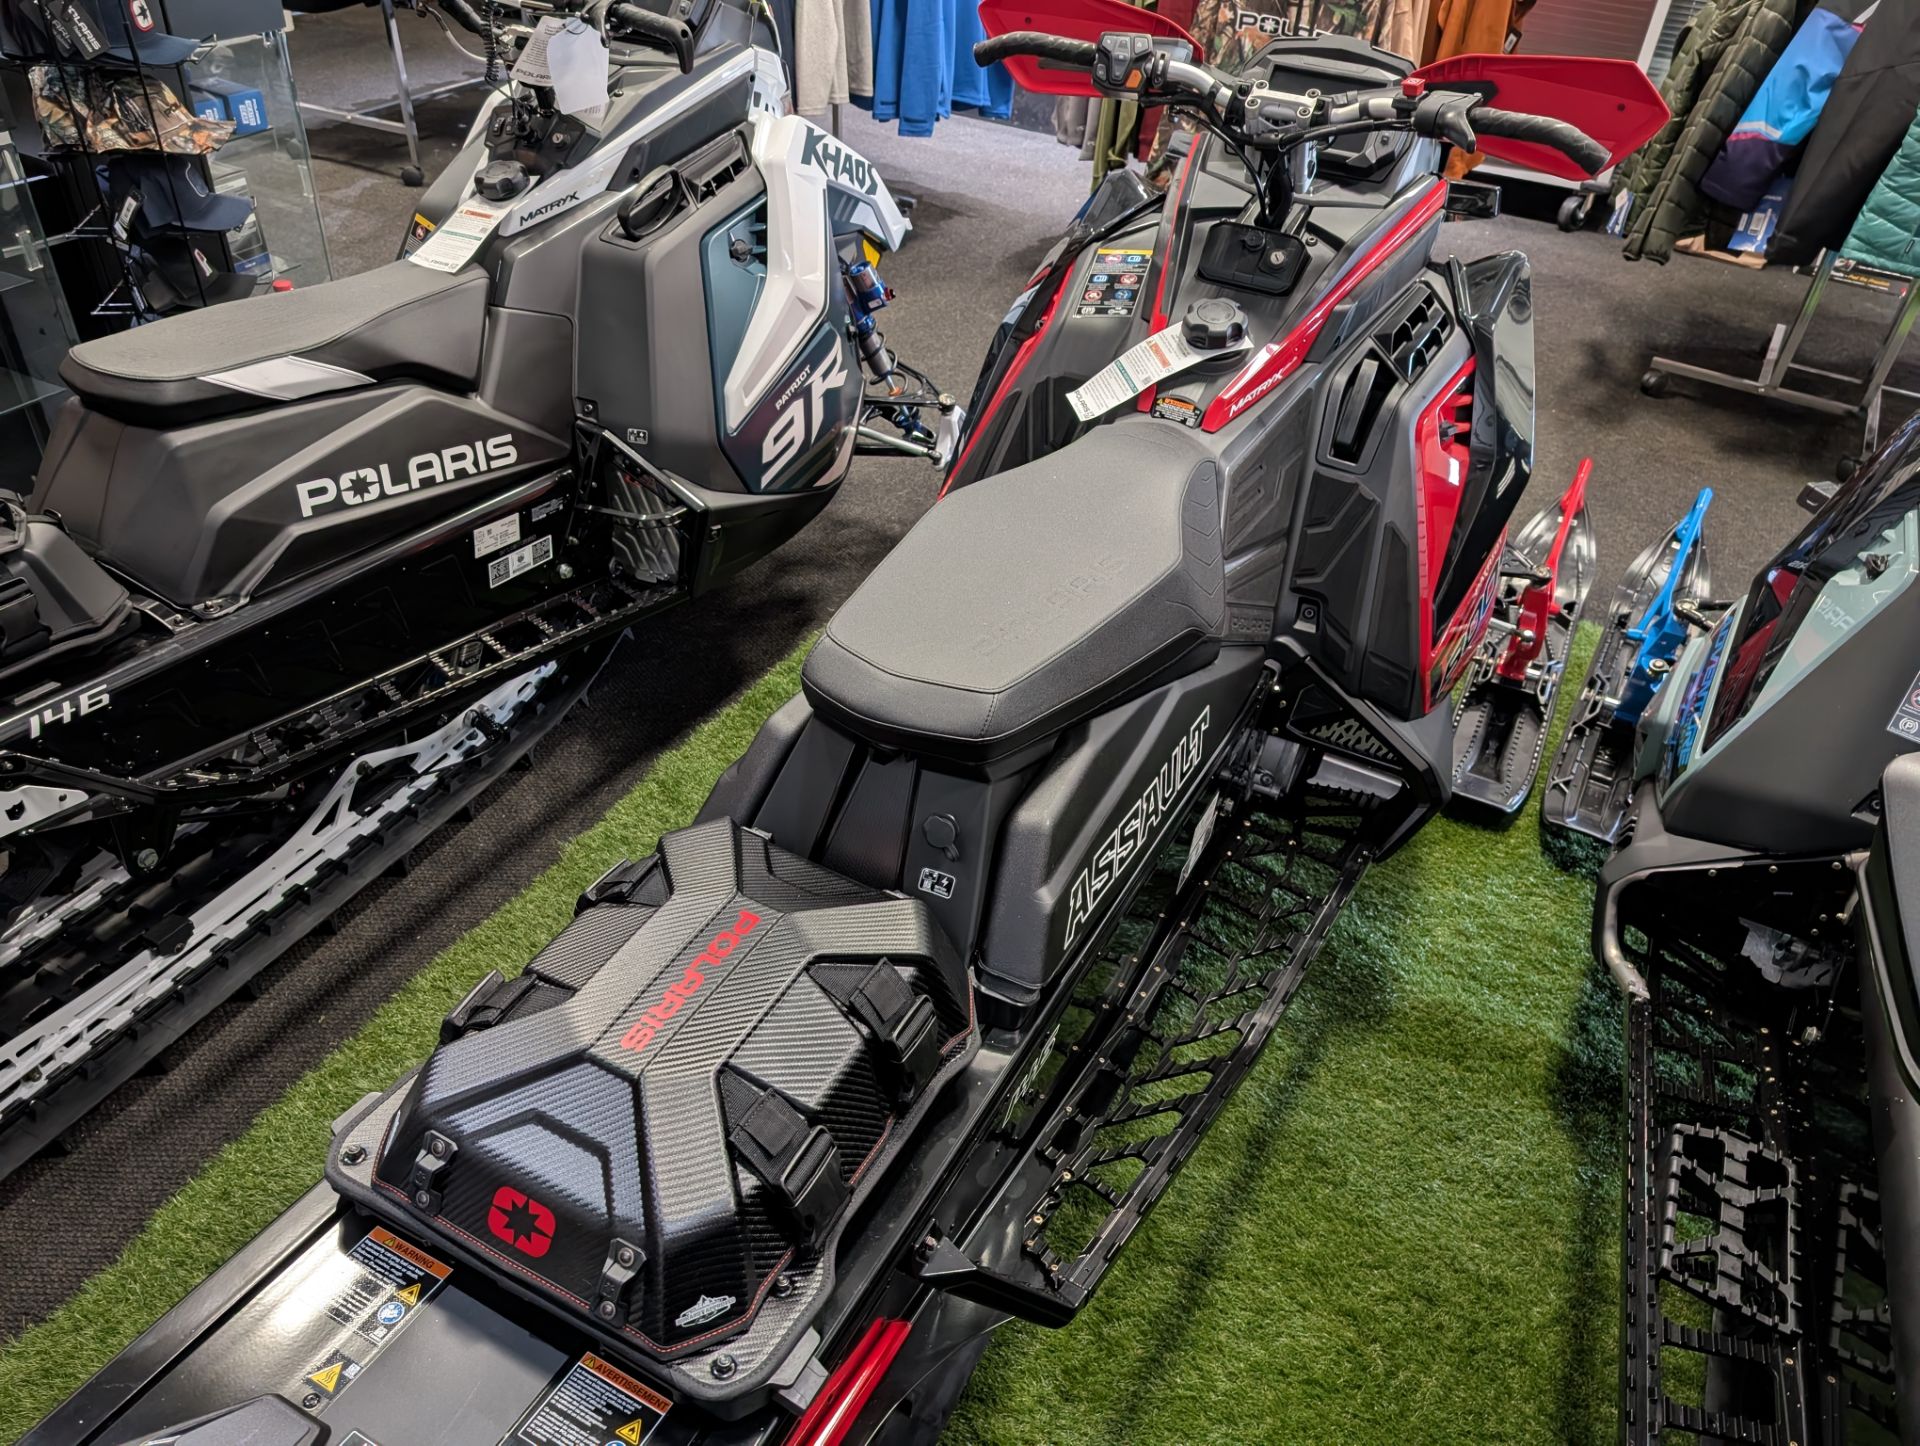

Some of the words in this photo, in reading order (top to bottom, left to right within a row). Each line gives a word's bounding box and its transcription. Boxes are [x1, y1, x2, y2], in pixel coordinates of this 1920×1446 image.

[67, 4, 101, 51] OLARIS
[515, 68, 552, 80] POLAR
[800, 125, 878, 196] KHAOS
[519, 191, 580, 227] MATRYX
[775, 364, 813, 412] PATRIOT
[1229, 368, 1284, 417] MATRYX
[761, 344, 849, 491] 9R
[296, 433, 518, 518] POLARIS
[30, 683, 110, 740] 146
[1675, 614, 1736, 769] ADVENTURE
[1064, 704, 1210, 950] ASSAULT
[620, 908, 762, 1054] POLARIS
[393, 1242, 435, 1268] WARNING
[594, 1362, 669, 1411] AVERTISSEMENT
